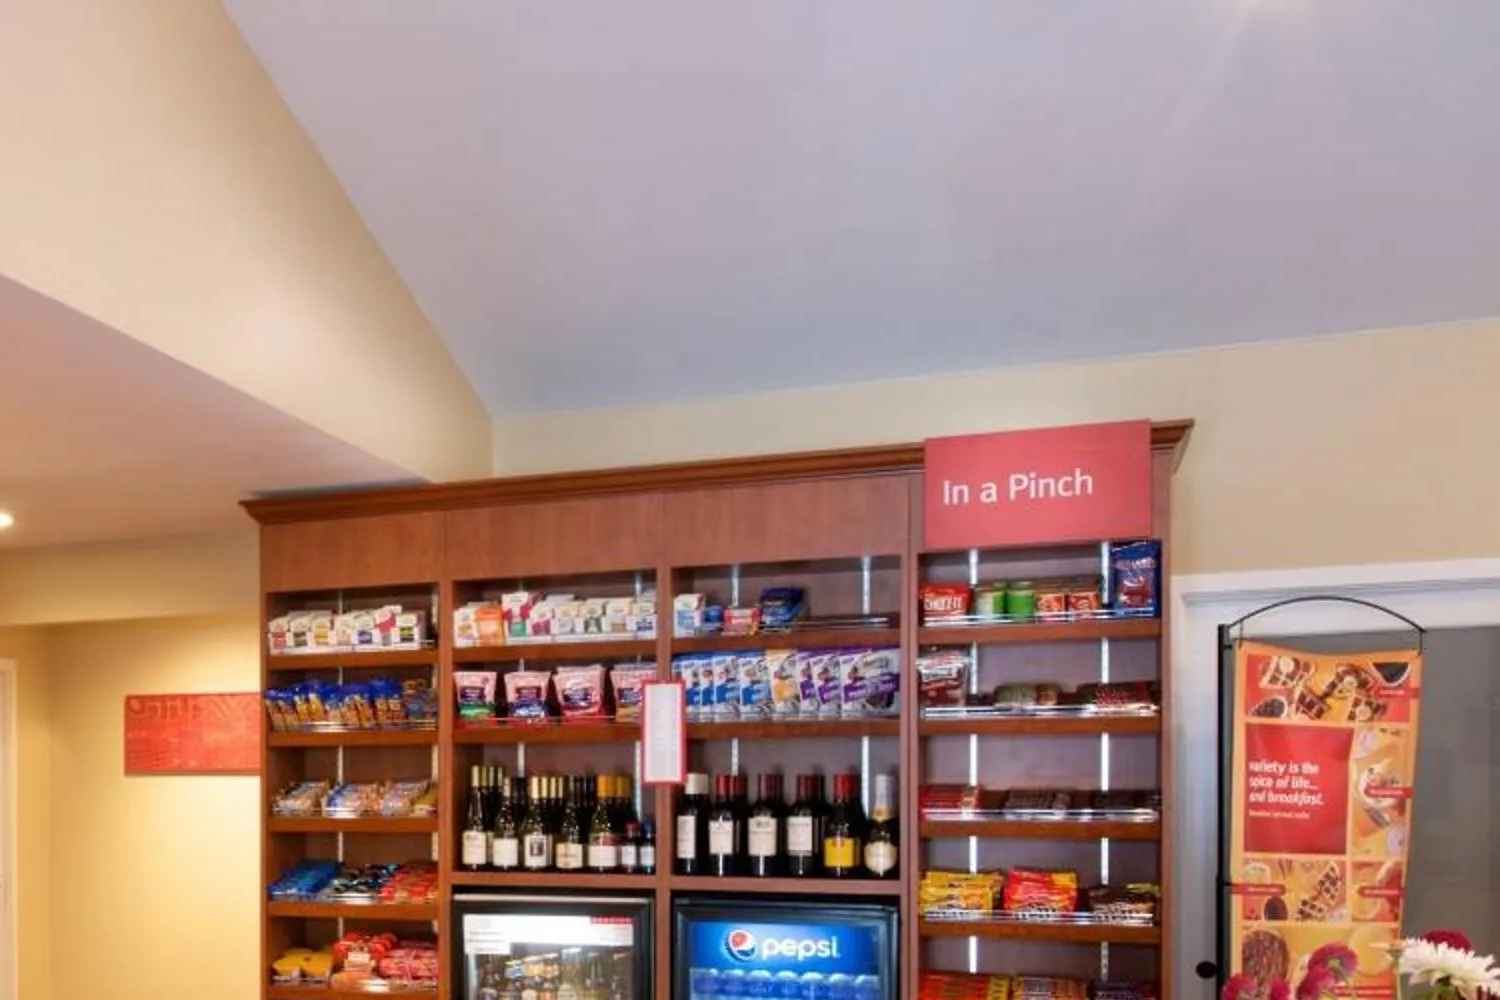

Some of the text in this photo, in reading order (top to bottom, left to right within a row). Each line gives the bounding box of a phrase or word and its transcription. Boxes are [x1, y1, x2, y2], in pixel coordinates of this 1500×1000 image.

[942, 467, 1094, 505] In a Pinch
[761, 935, 839, 961] pepsi
